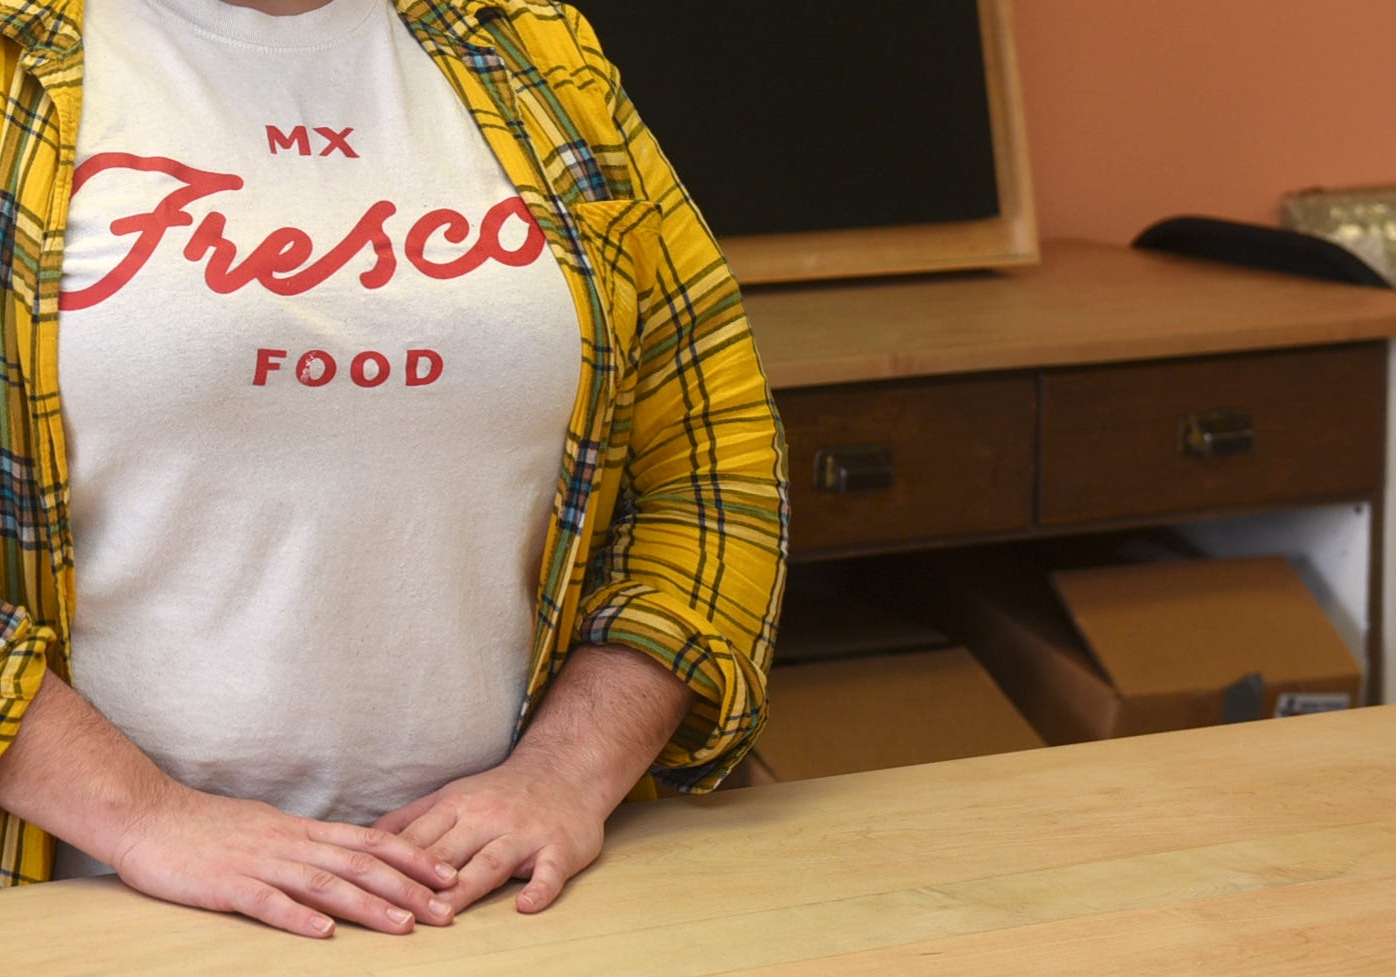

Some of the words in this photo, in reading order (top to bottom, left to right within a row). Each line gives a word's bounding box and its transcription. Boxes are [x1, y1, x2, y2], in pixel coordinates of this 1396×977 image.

[265, 124, 360, 158] MX
[58, 151, 547, 311] Fresco
[252, 348, 444, 388] FOOD
